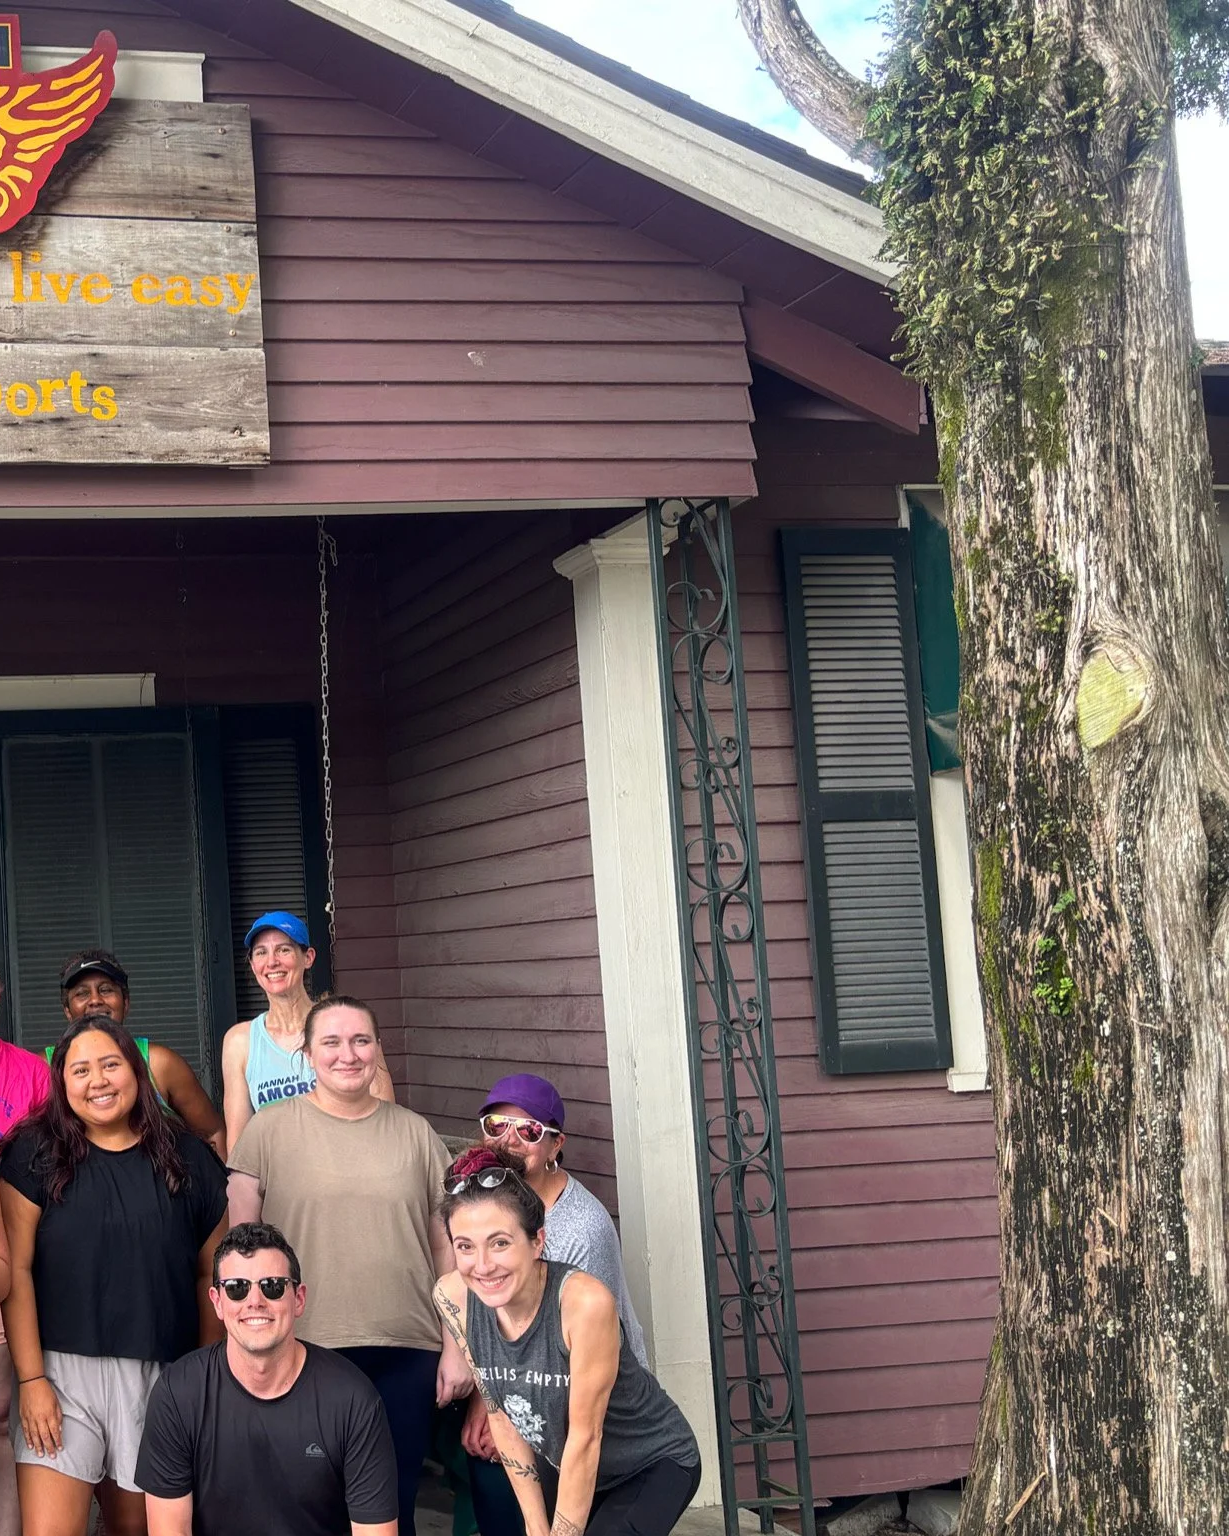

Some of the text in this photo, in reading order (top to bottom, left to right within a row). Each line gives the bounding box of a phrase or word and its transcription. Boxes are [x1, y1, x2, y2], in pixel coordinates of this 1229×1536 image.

[8, 251, 257, 314] live easy
[257, 1074, 299, 1091] HANNAH
[524, 1370, 570, 1387] EMPTY
